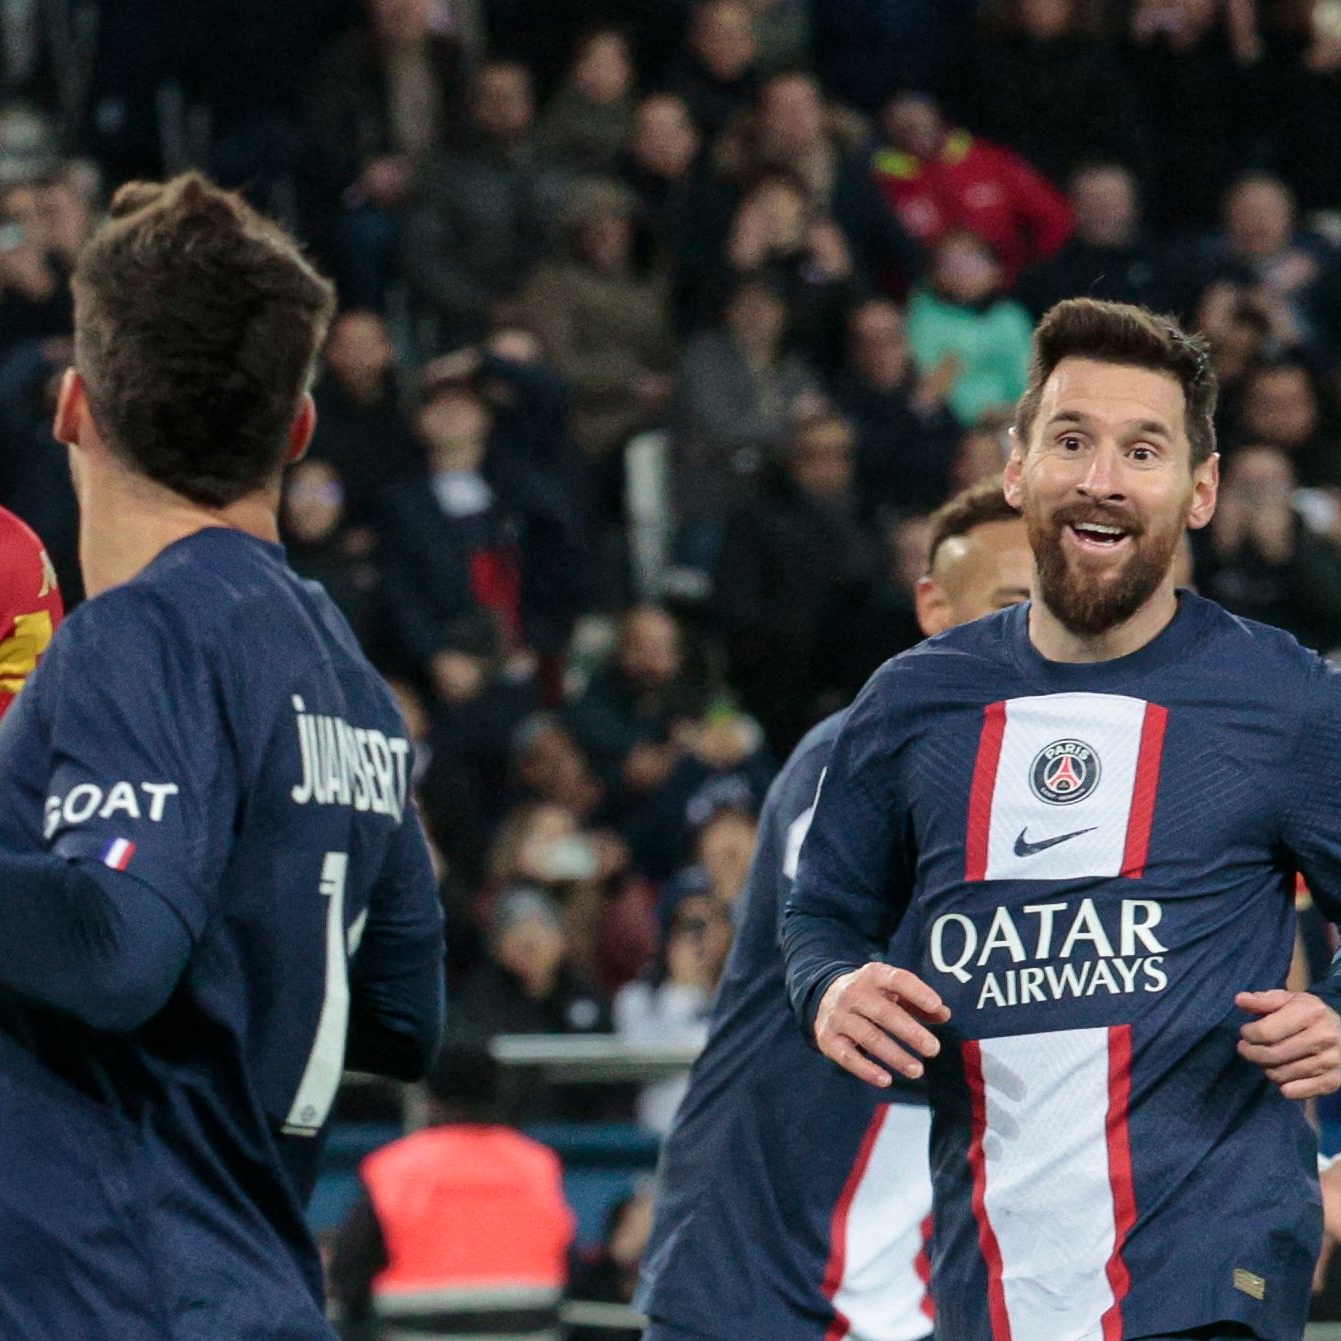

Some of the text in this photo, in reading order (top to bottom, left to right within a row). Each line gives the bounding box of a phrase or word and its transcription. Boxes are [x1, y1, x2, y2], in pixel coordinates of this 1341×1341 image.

[1045, 743, 1091, 760] PARIS
[930, 898, 1170, 984] QATAR
[976, 955, 1169, 1010] AIRWAYS
